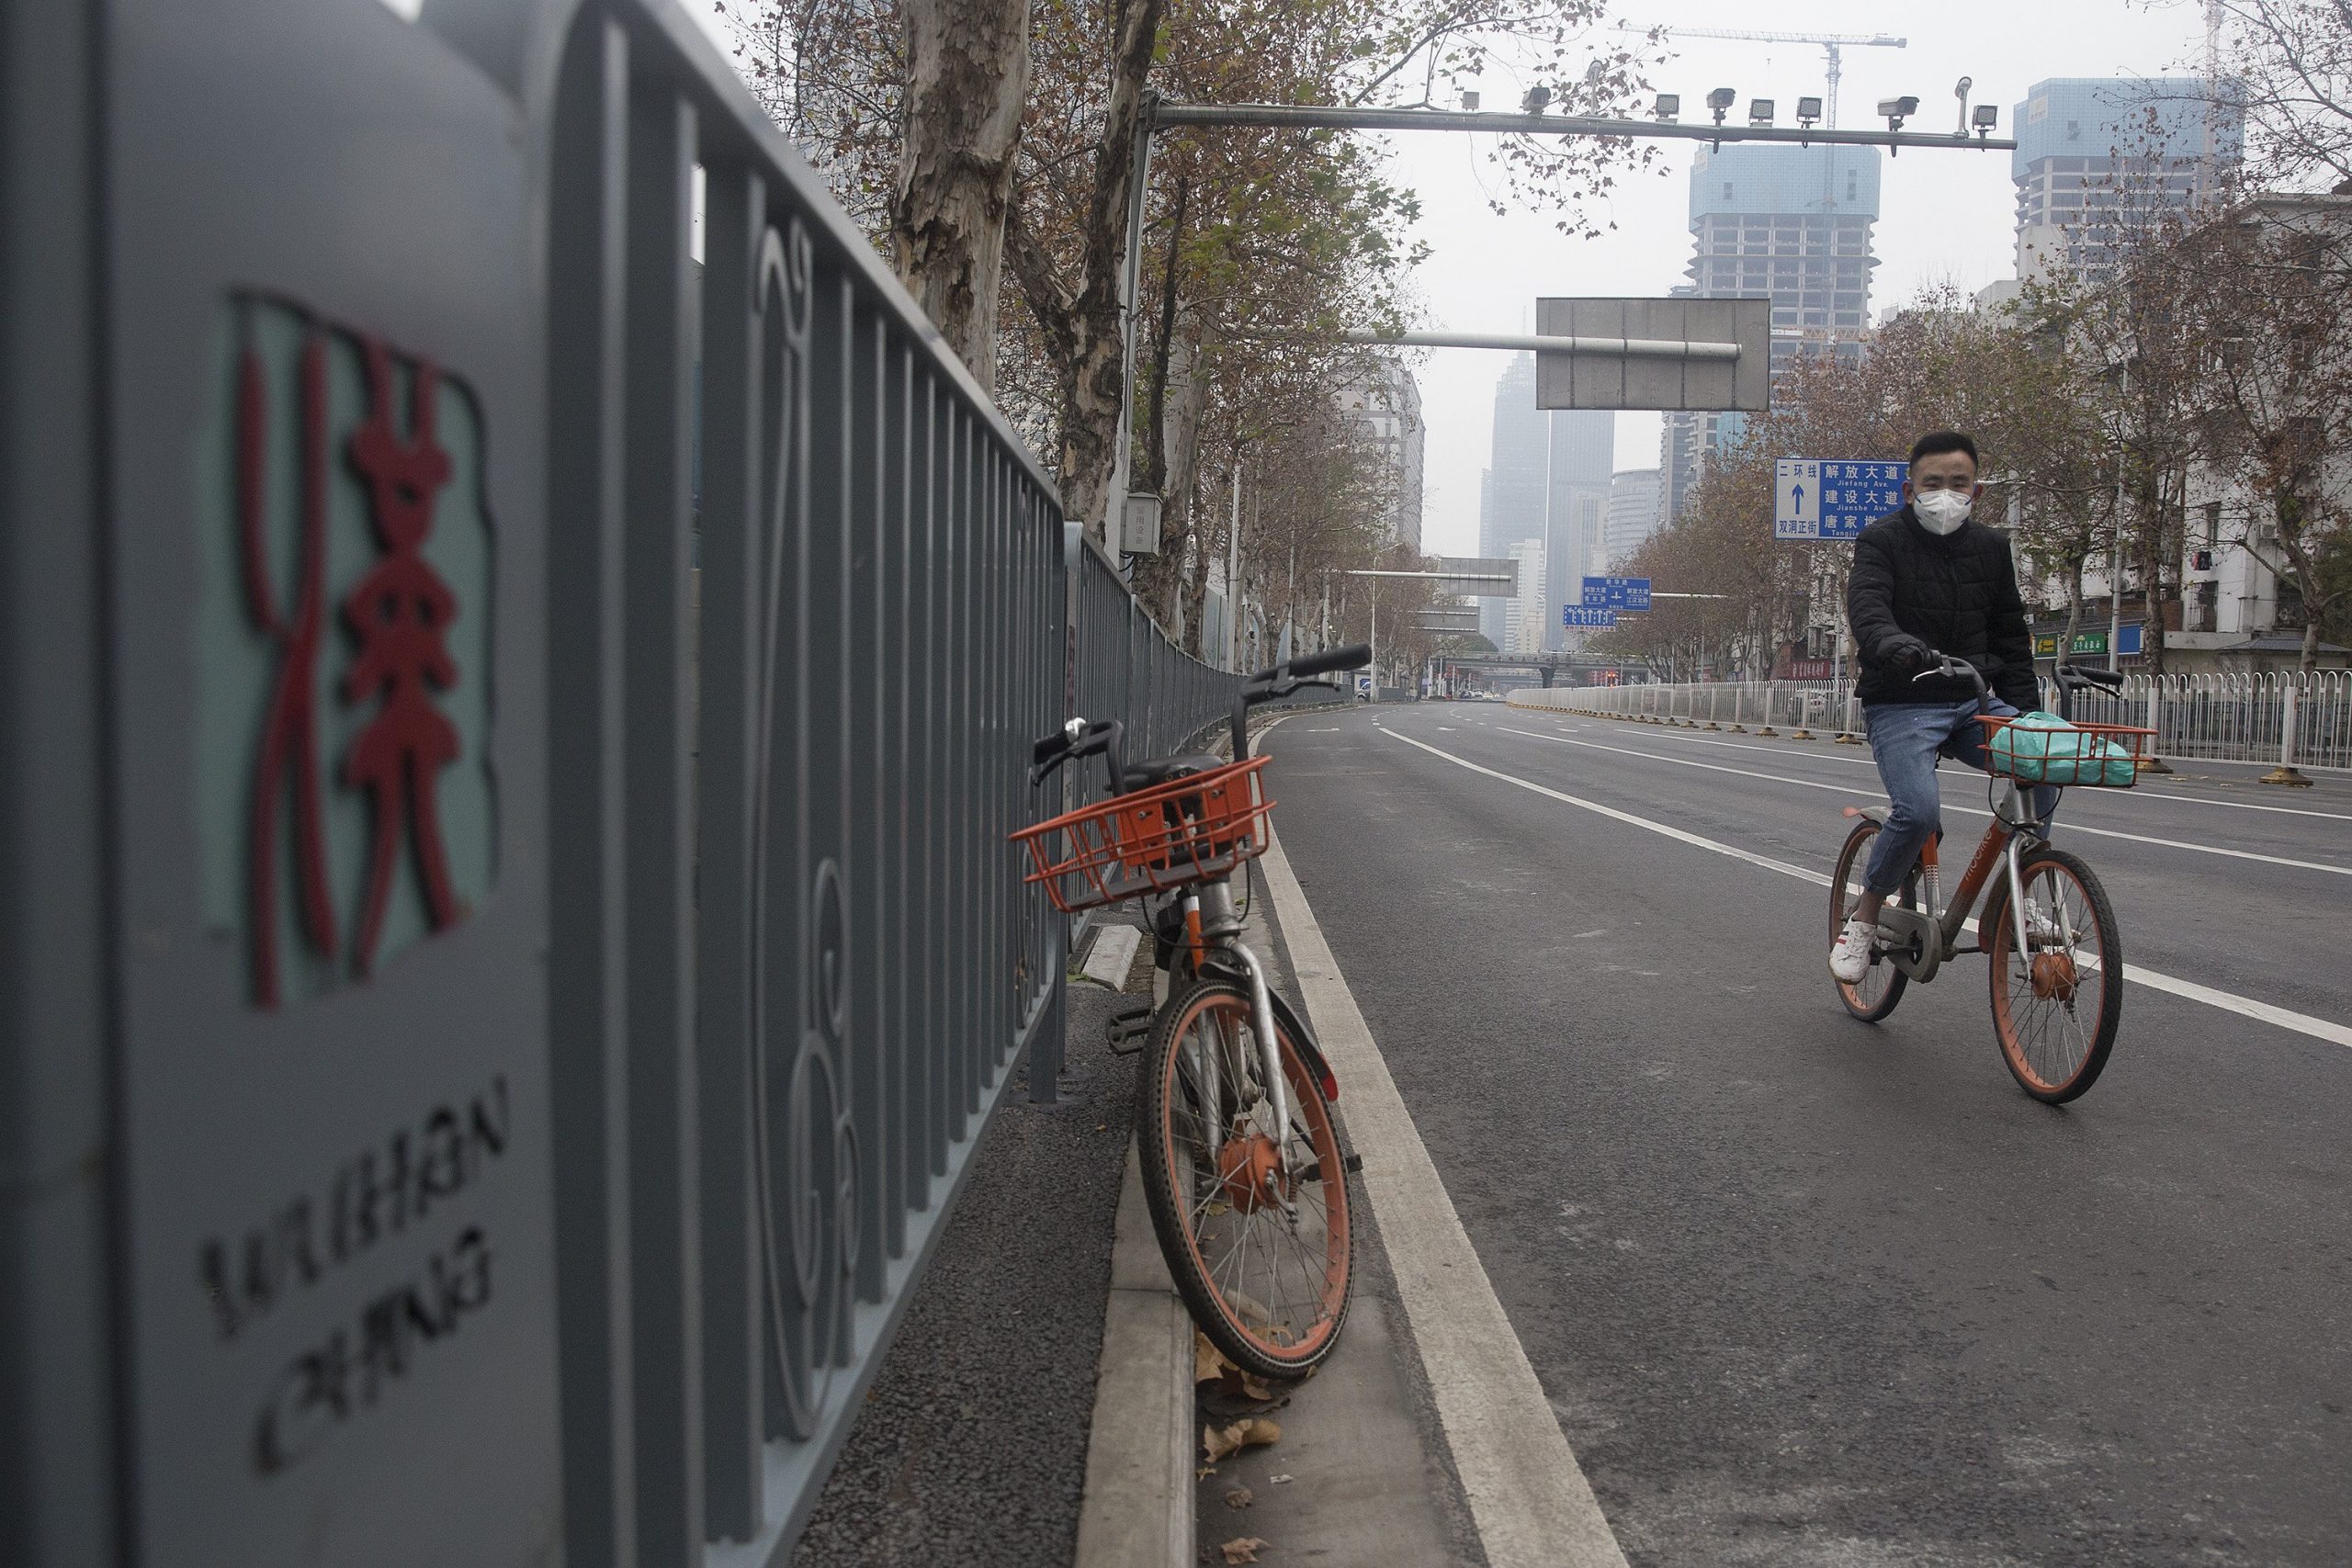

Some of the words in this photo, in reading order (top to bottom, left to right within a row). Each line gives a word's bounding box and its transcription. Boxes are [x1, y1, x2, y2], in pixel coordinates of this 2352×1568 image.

[1780, 464, 1817, 478] 二环线
[1826, 465, 1898, 479] 解放大道
[1838, 479, 1868, 488] Jiefang
[1825, 490, 1898, 505] 建设大道
[1779, 520, 1816, 534] 双洞正街
